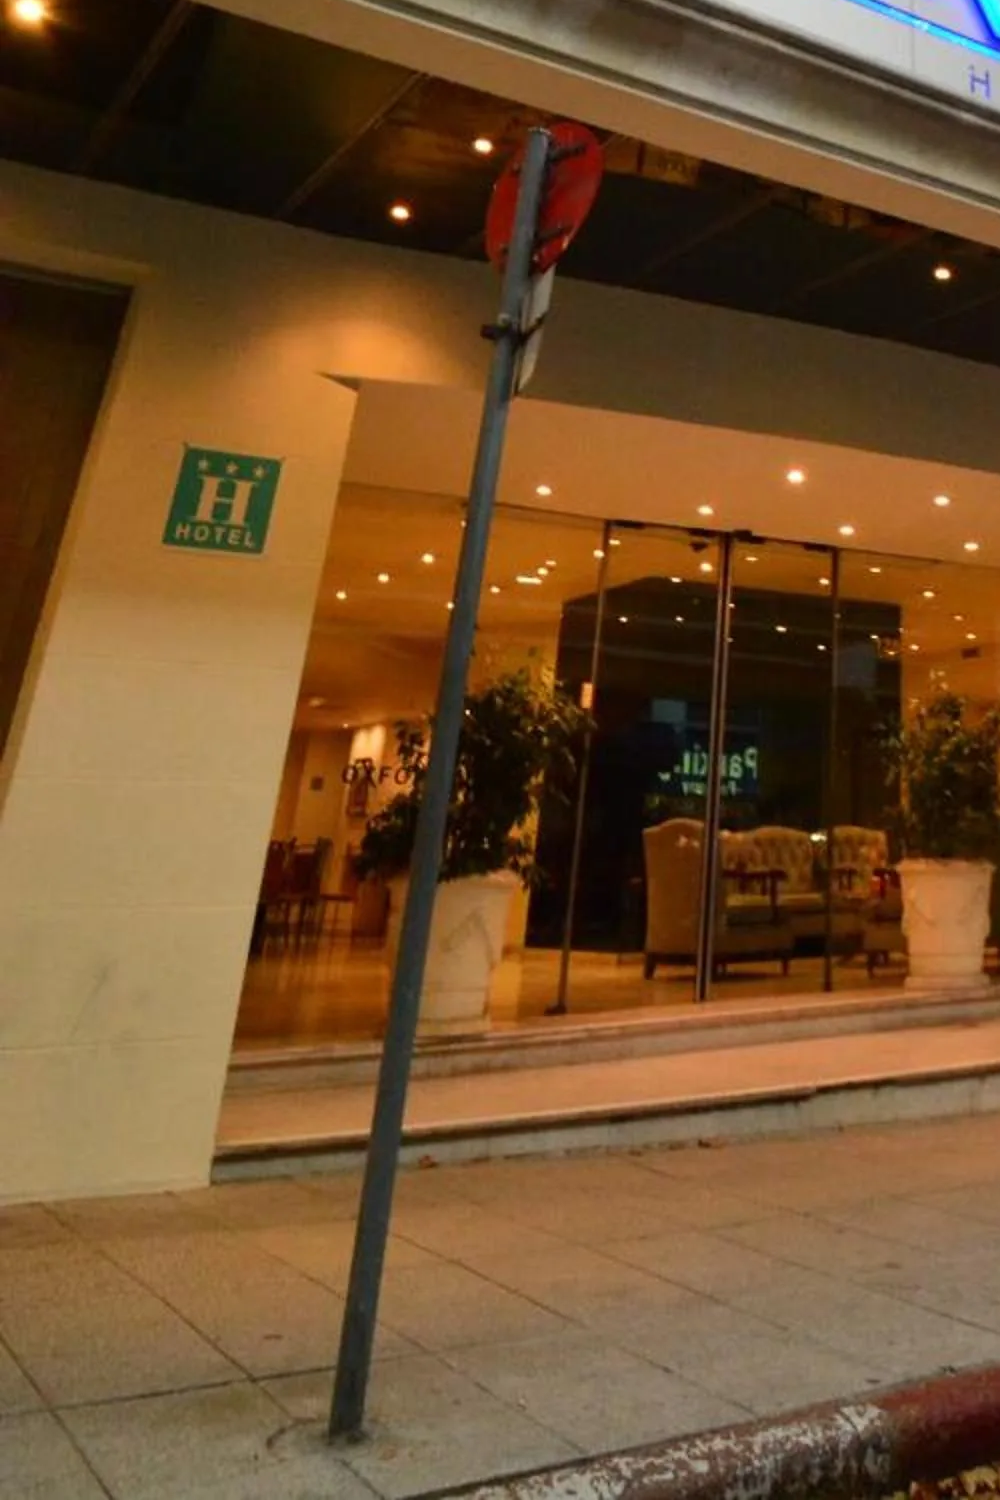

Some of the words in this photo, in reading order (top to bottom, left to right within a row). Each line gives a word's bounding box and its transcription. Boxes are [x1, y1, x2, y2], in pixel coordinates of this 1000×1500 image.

[190, 473, 258, 527] H
[175, 523, 256, 548] HOTEL
[342, 762, 410, 788] OXFO
